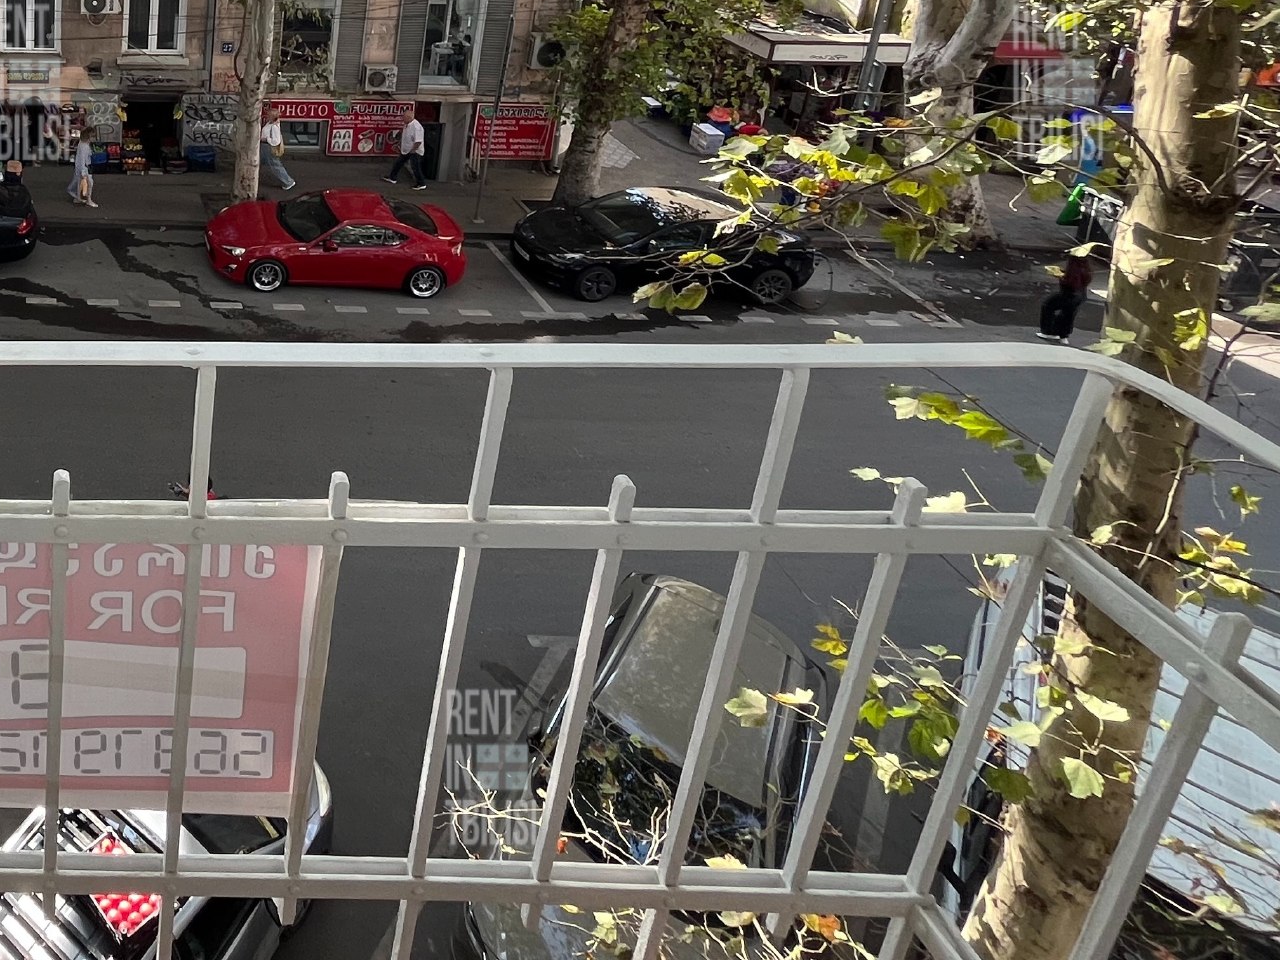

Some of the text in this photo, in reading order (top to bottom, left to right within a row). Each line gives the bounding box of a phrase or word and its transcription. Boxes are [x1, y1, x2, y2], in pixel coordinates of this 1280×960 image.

[223, 44, 233, 52] 27
[278, 104, 328, 117] PHOTO
[349, 103, 411, 116] FUJIFILM
